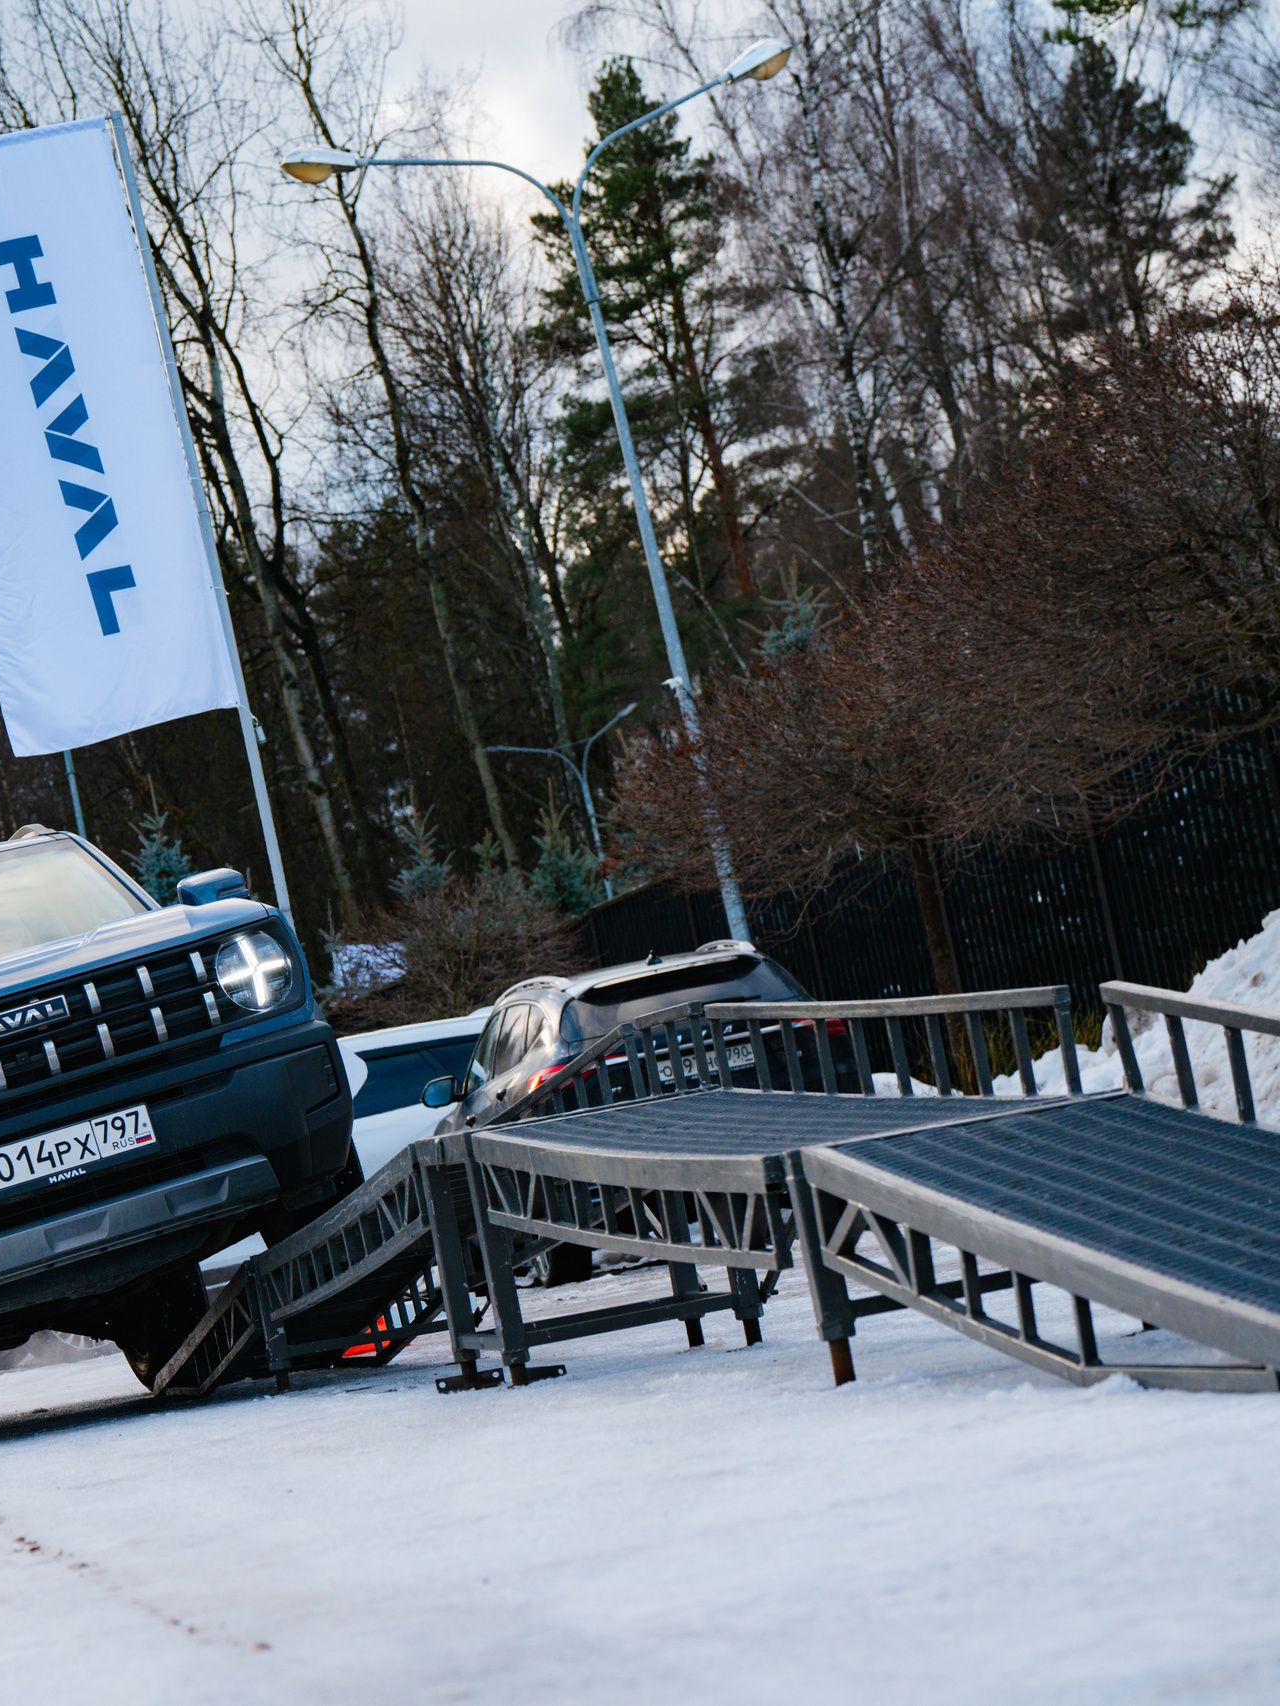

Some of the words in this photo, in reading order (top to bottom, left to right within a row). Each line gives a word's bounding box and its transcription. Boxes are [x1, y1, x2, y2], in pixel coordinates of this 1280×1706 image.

[94, 1110, 140, 1145] 797
[111, 1136, 136, 1151] RUS
[48, 1167, 87, 1184] HAVAL
